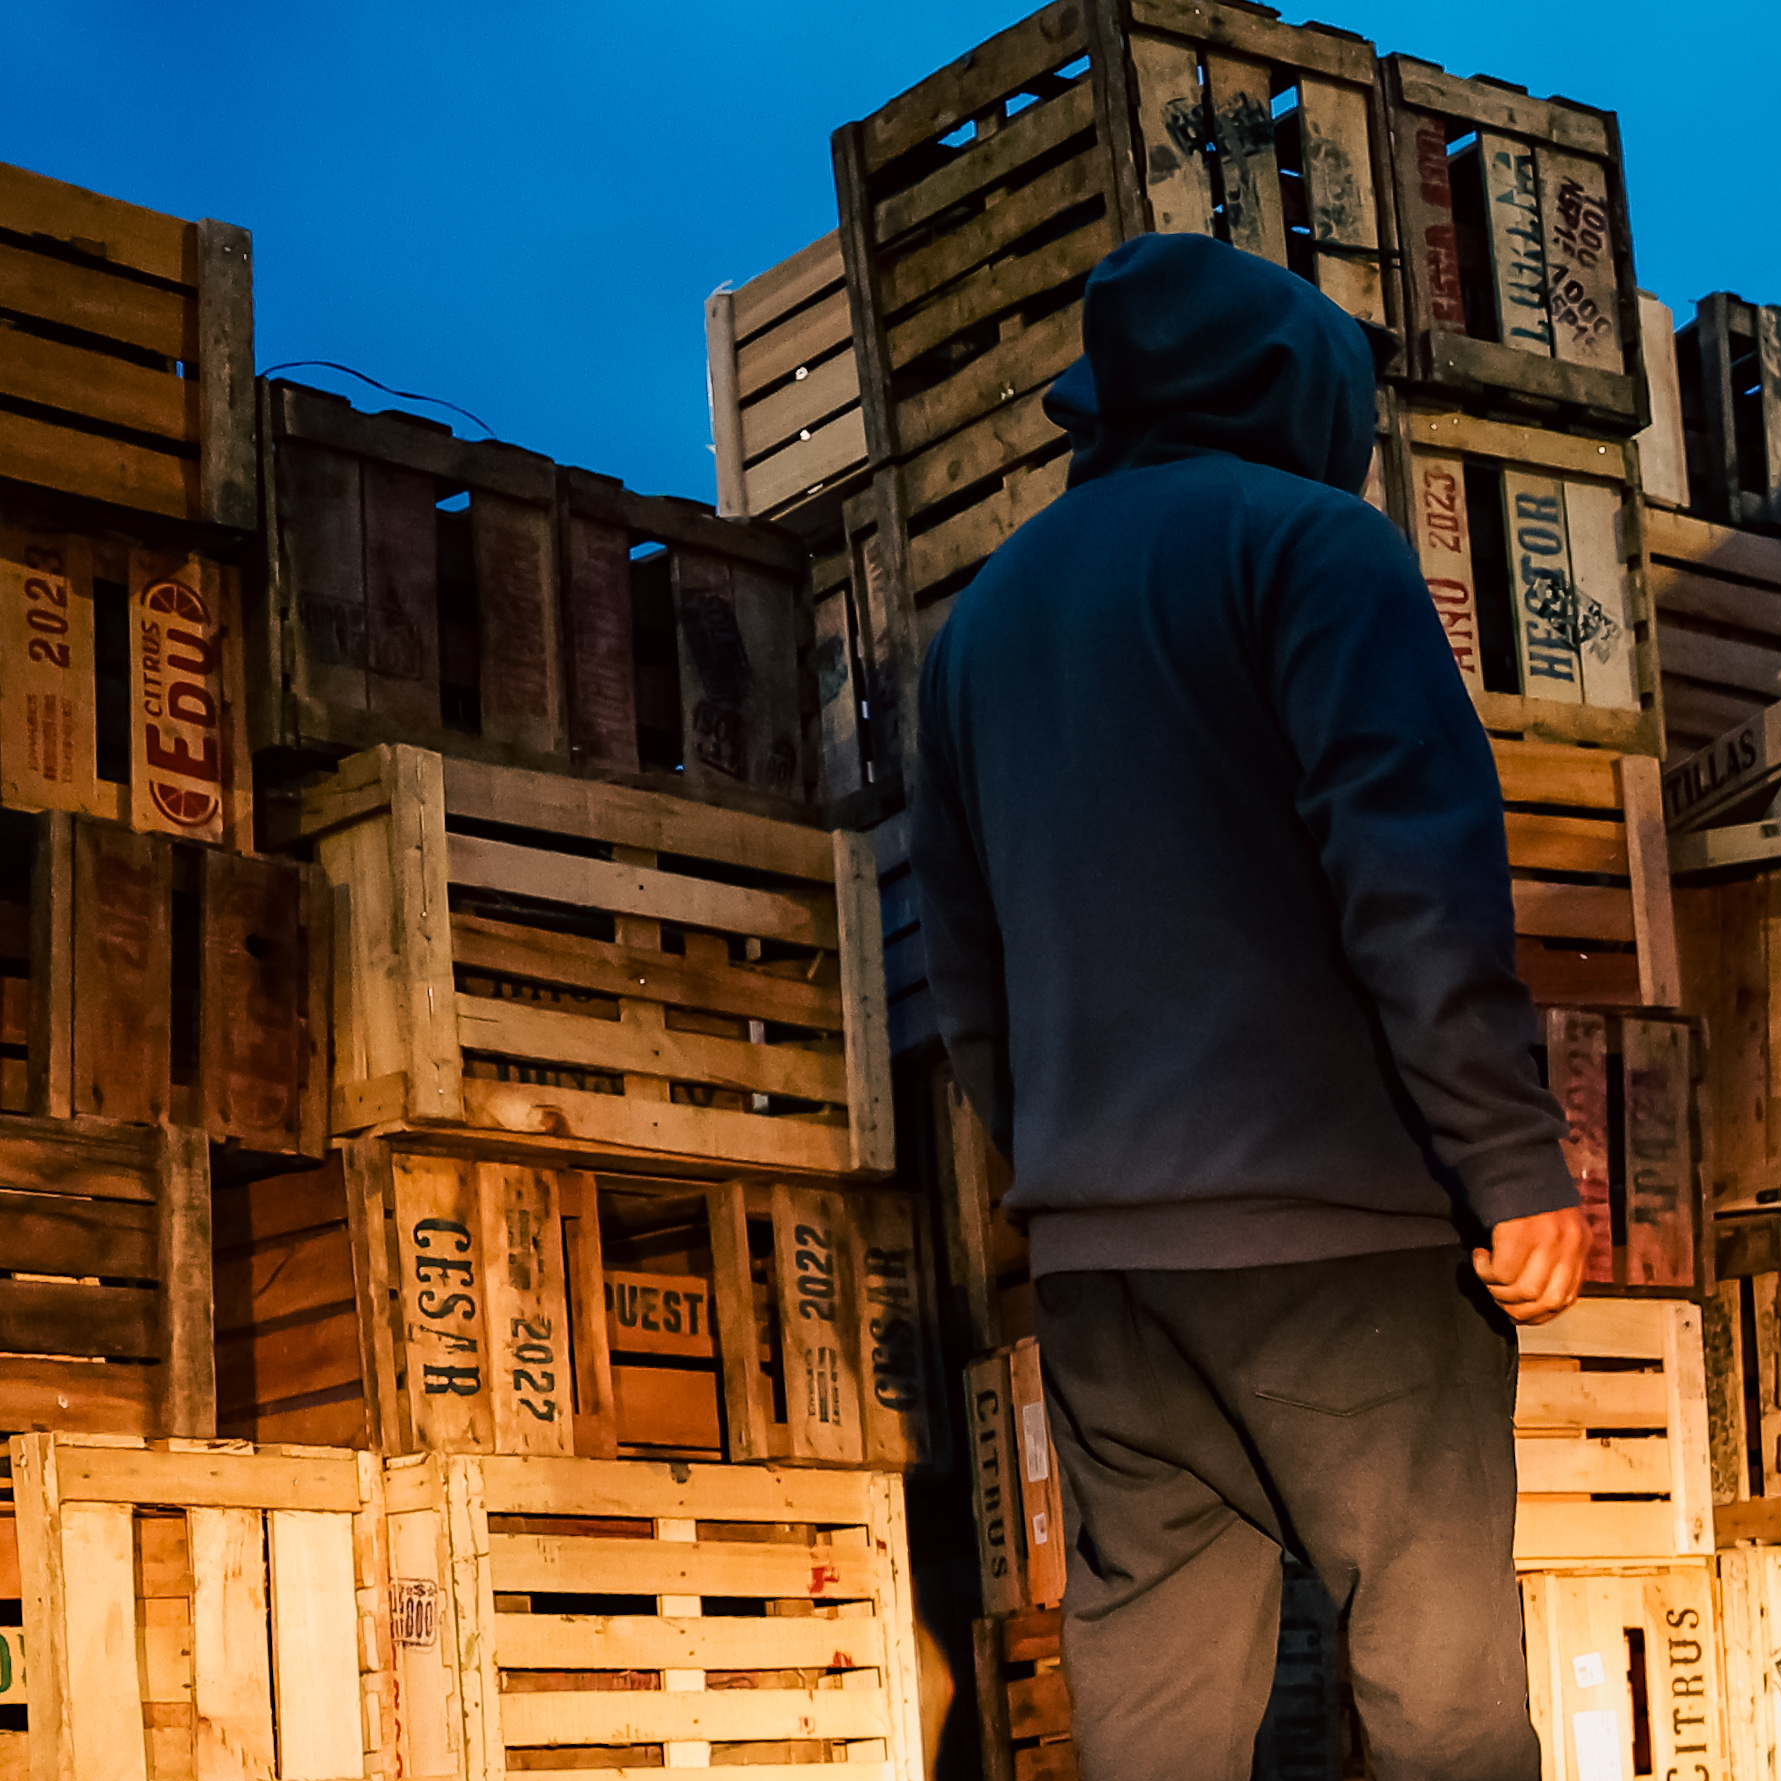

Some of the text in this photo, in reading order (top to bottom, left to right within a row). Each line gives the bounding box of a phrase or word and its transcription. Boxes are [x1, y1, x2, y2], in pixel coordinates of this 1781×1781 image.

[24, 544, 71, 669] 2023
[141, 618, 163, 718] CITRUS
[146, 622, 220, 783] EDU
[794, 1223, 834, 1322] 2022
[975, 1387, 1009, 1581] CITRUS
